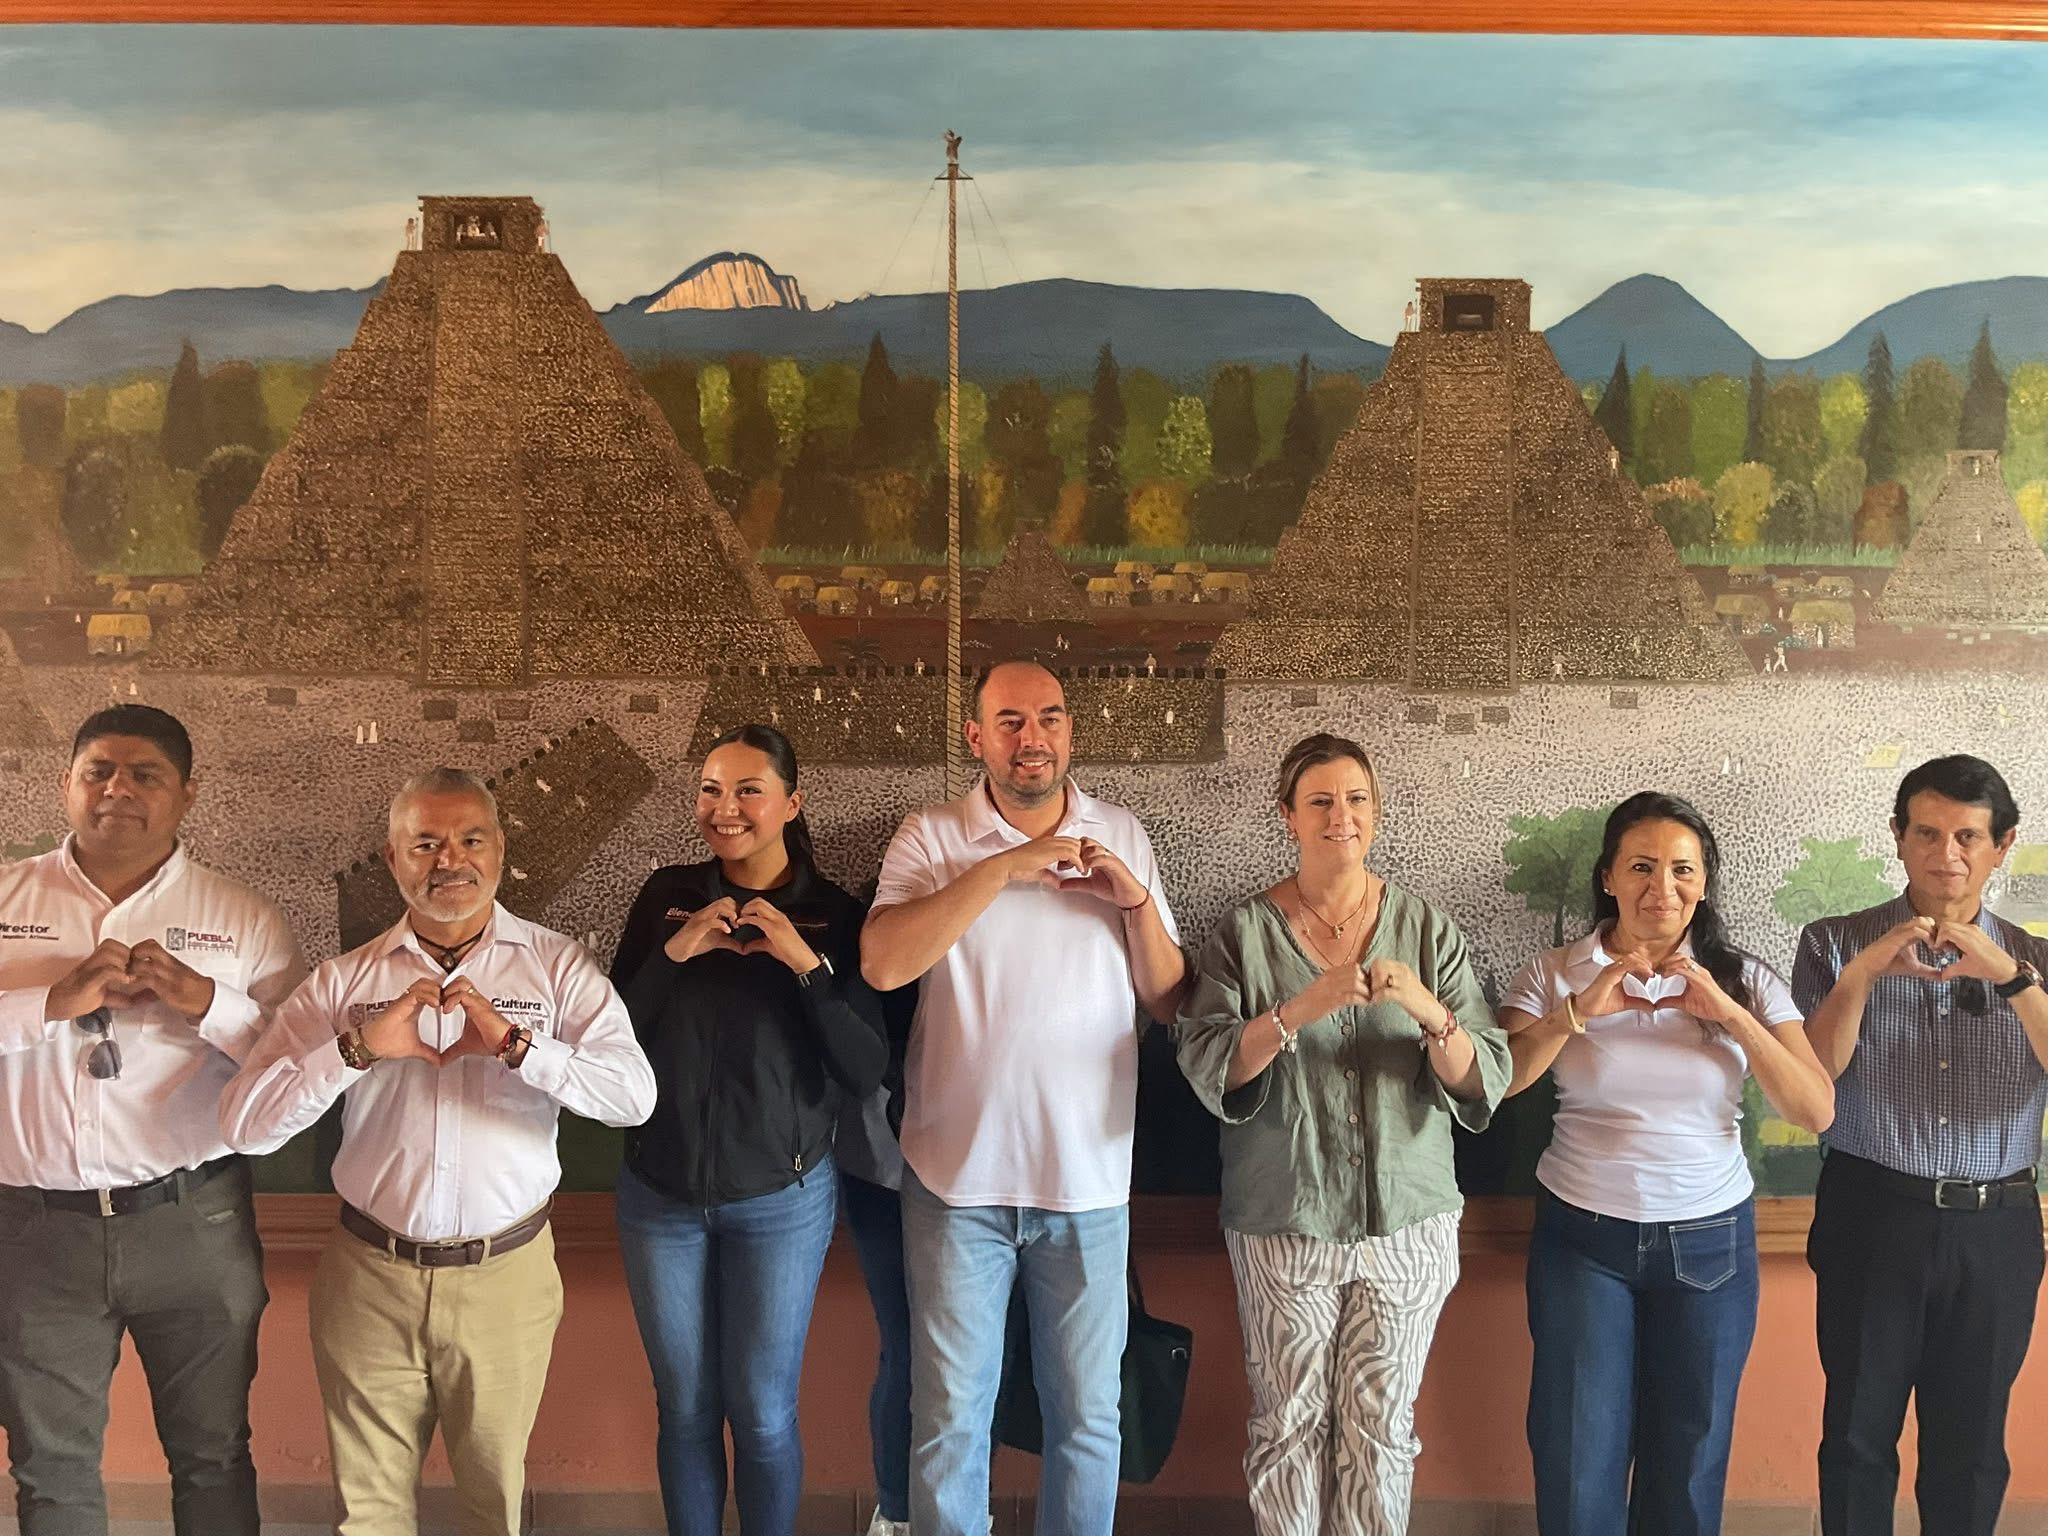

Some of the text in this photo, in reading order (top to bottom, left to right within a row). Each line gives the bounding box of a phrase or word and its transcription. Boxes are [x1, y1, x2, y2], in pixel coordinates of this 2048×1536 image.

[667, 907, 691, 917] Bien
[188, 932, 233, 943] PUEBLA
[366, 1000, 393, 1011] PUE
[491, 998, 541, 1010] Cultura
